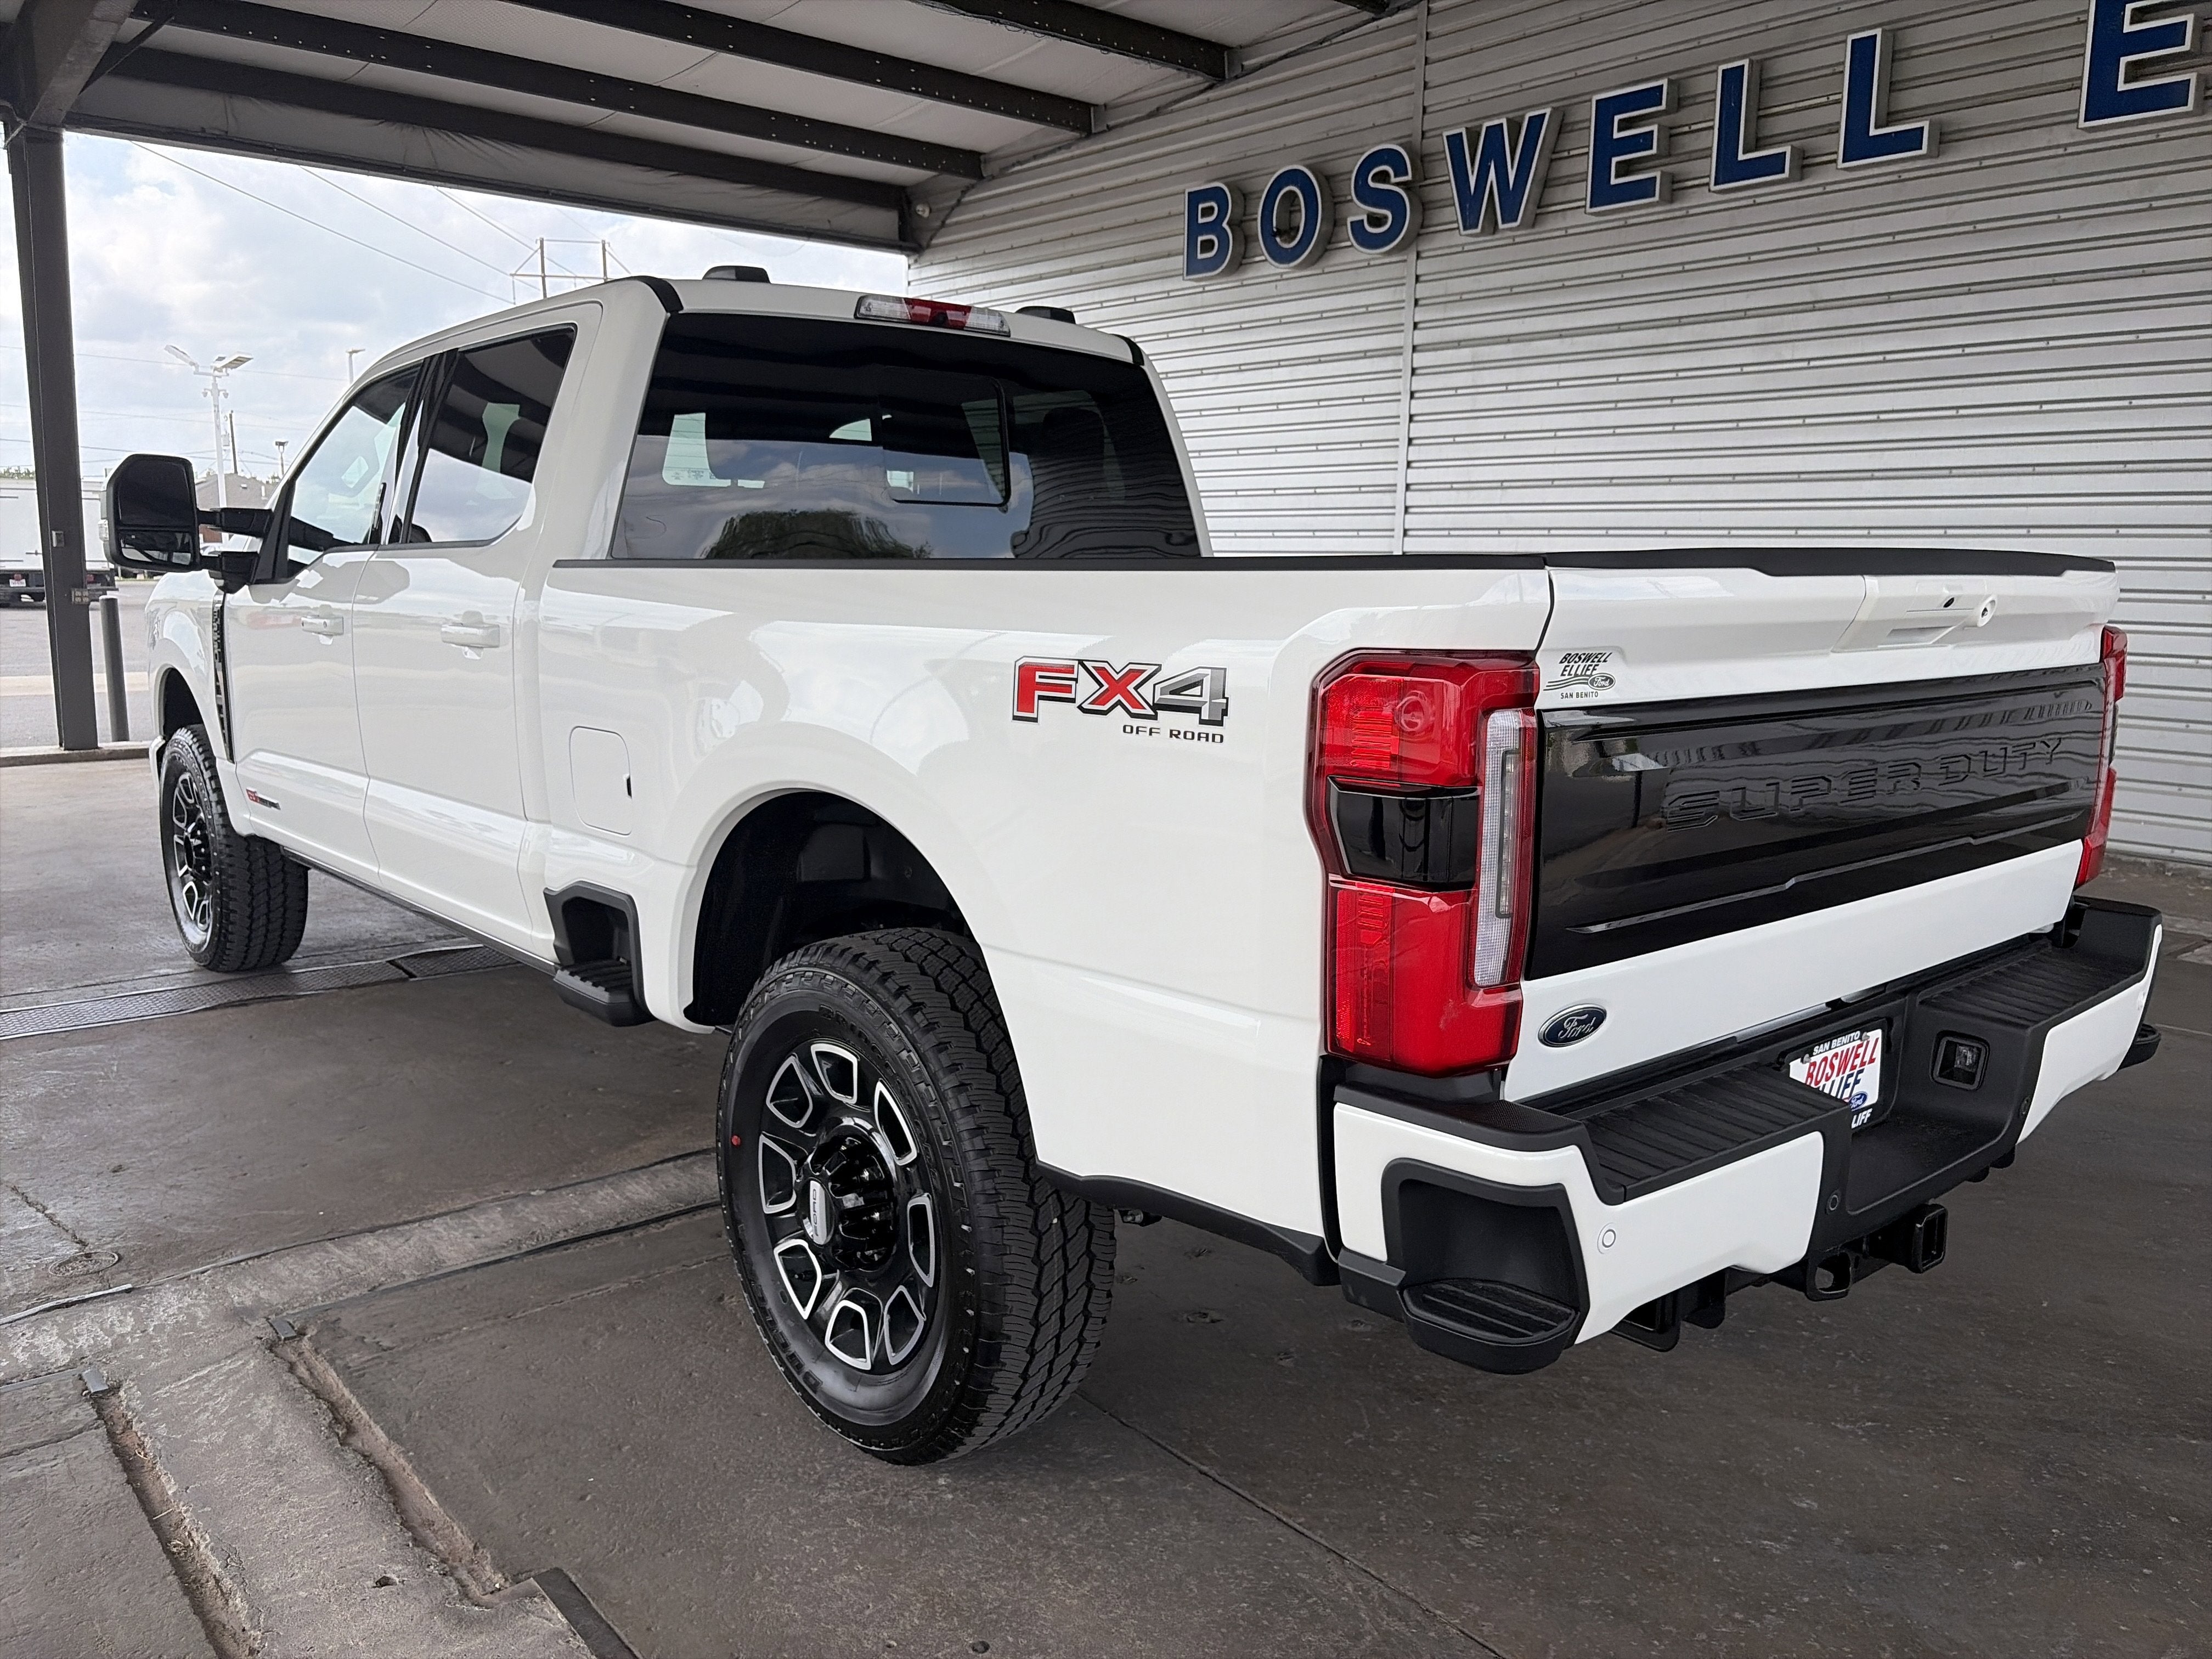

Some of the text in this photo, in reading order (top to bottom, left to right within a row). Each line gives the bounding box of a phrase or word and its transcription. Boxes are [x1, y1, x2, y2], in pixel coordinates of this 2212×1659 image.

[1183, 28, 1937, 280] BOSWELL
[1559, 652, 1613, 664] BOSWELL
[1560, 664, 1600, 676] ELLIFF
[1012, 656, 1230, 727] FX4
[1593, 676, 1610, 686] Ford
[1122, 725, 1224, 743] OFF ROAD
[1666, 737, 2063, 832] SUPER DUTY
[1558, 1014, 1596, 1039] Ford
[1812, 1031, 1860, 1056] SAN BENITO
[1805, 1037, 1880, 1086] BOSWELL
